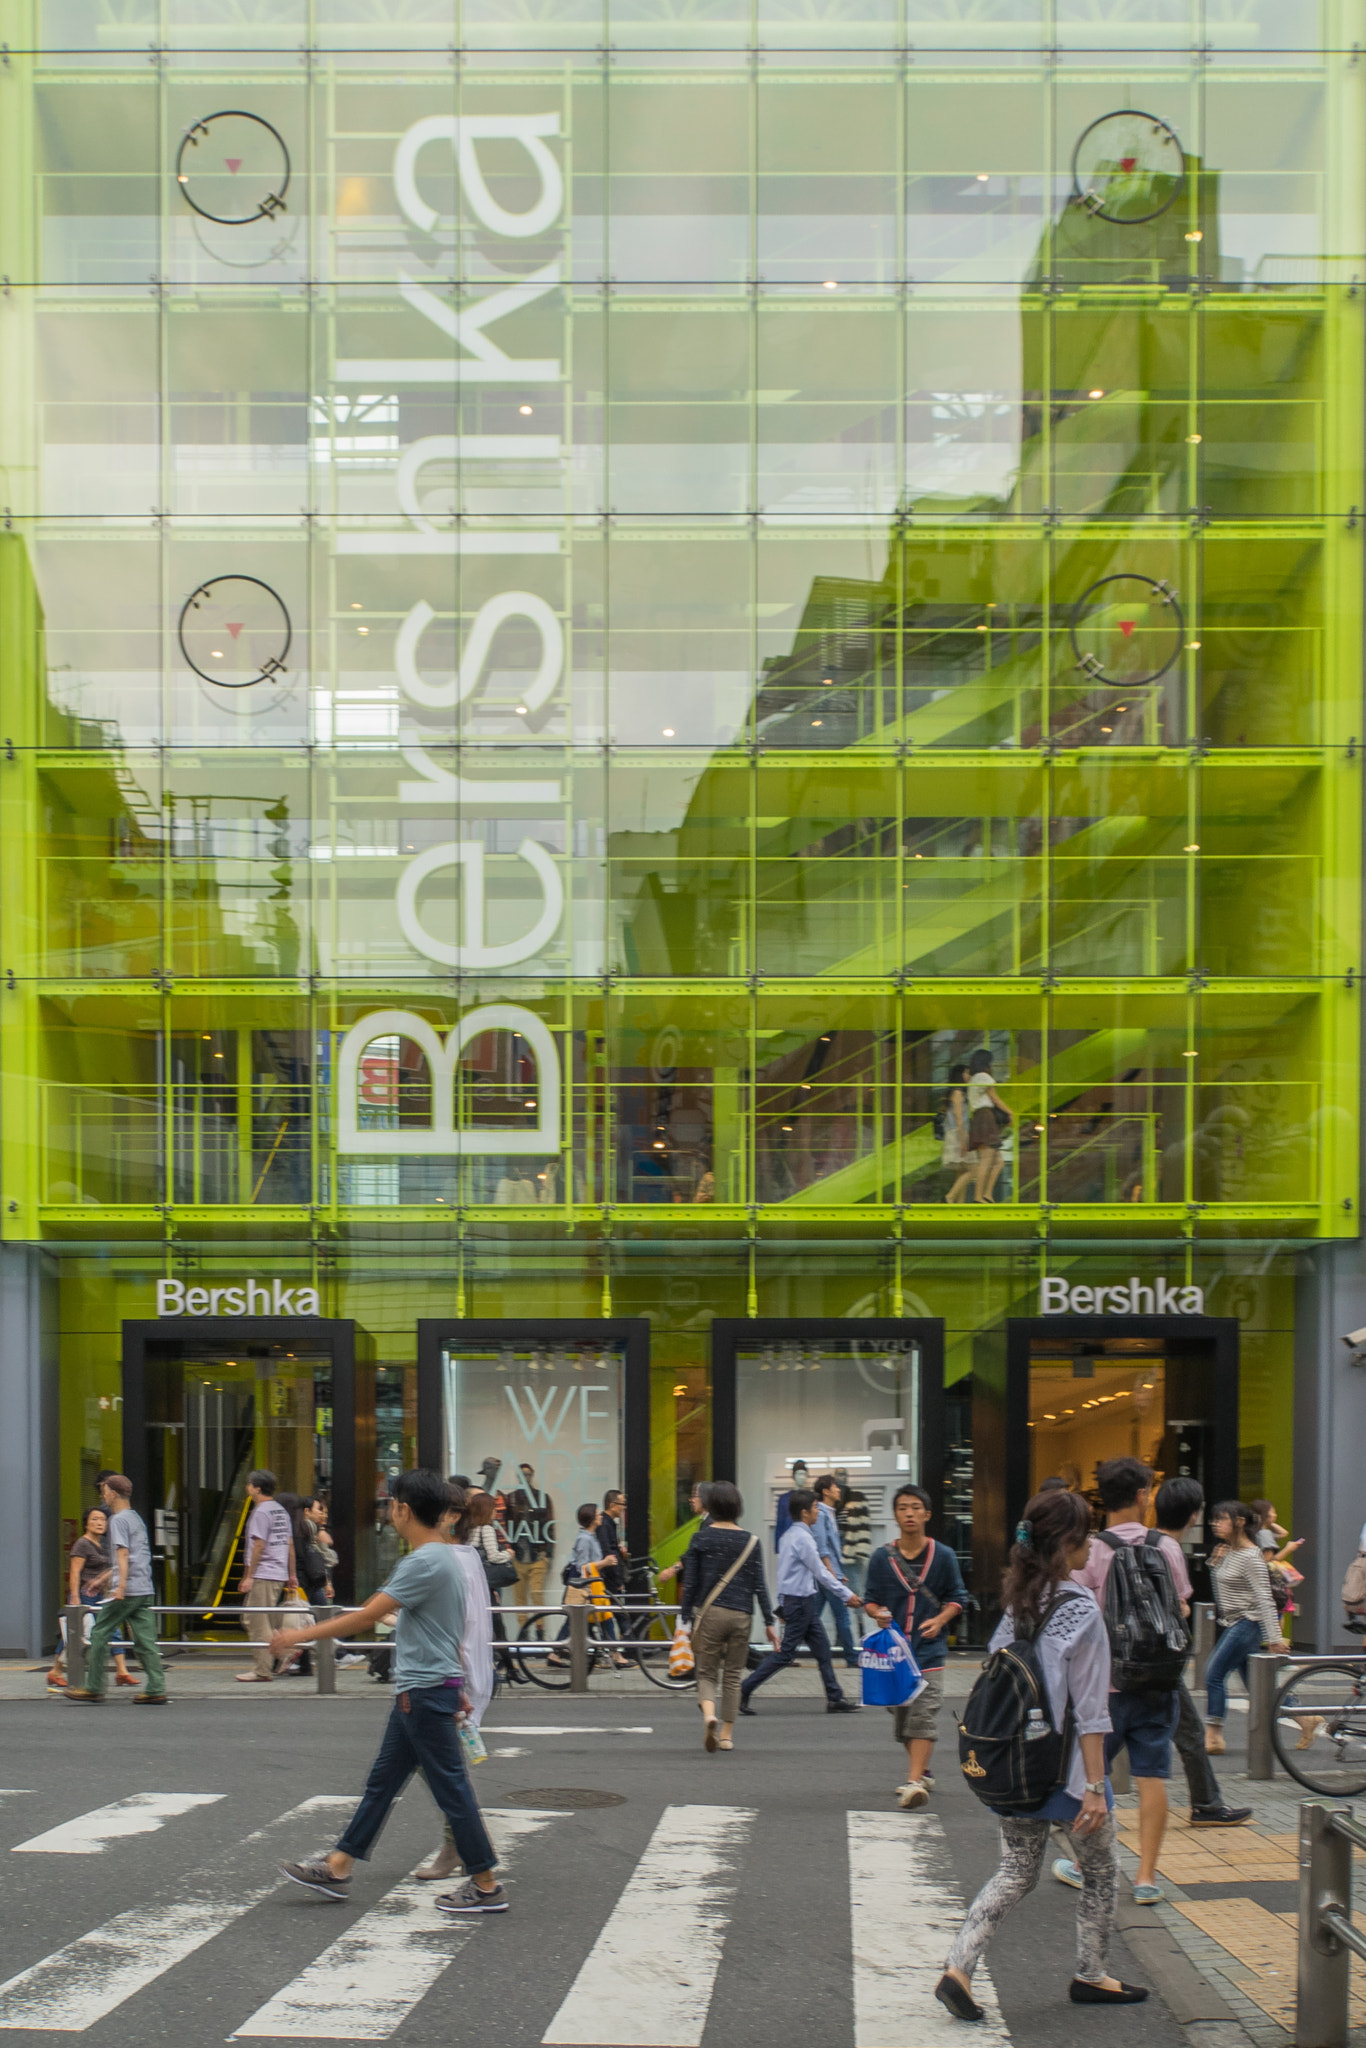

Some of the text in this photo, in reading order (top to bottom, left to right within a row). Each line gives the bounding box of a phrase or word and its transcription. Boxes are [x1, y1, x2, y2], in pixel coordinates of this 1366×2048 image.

[334, 111, 564, 1155] Bershka
[156, 1278, 320, 1317] Bershka
[1040, 1276, 1204, 1316] Bershka
[503, 1385, 610, 1444] WE
